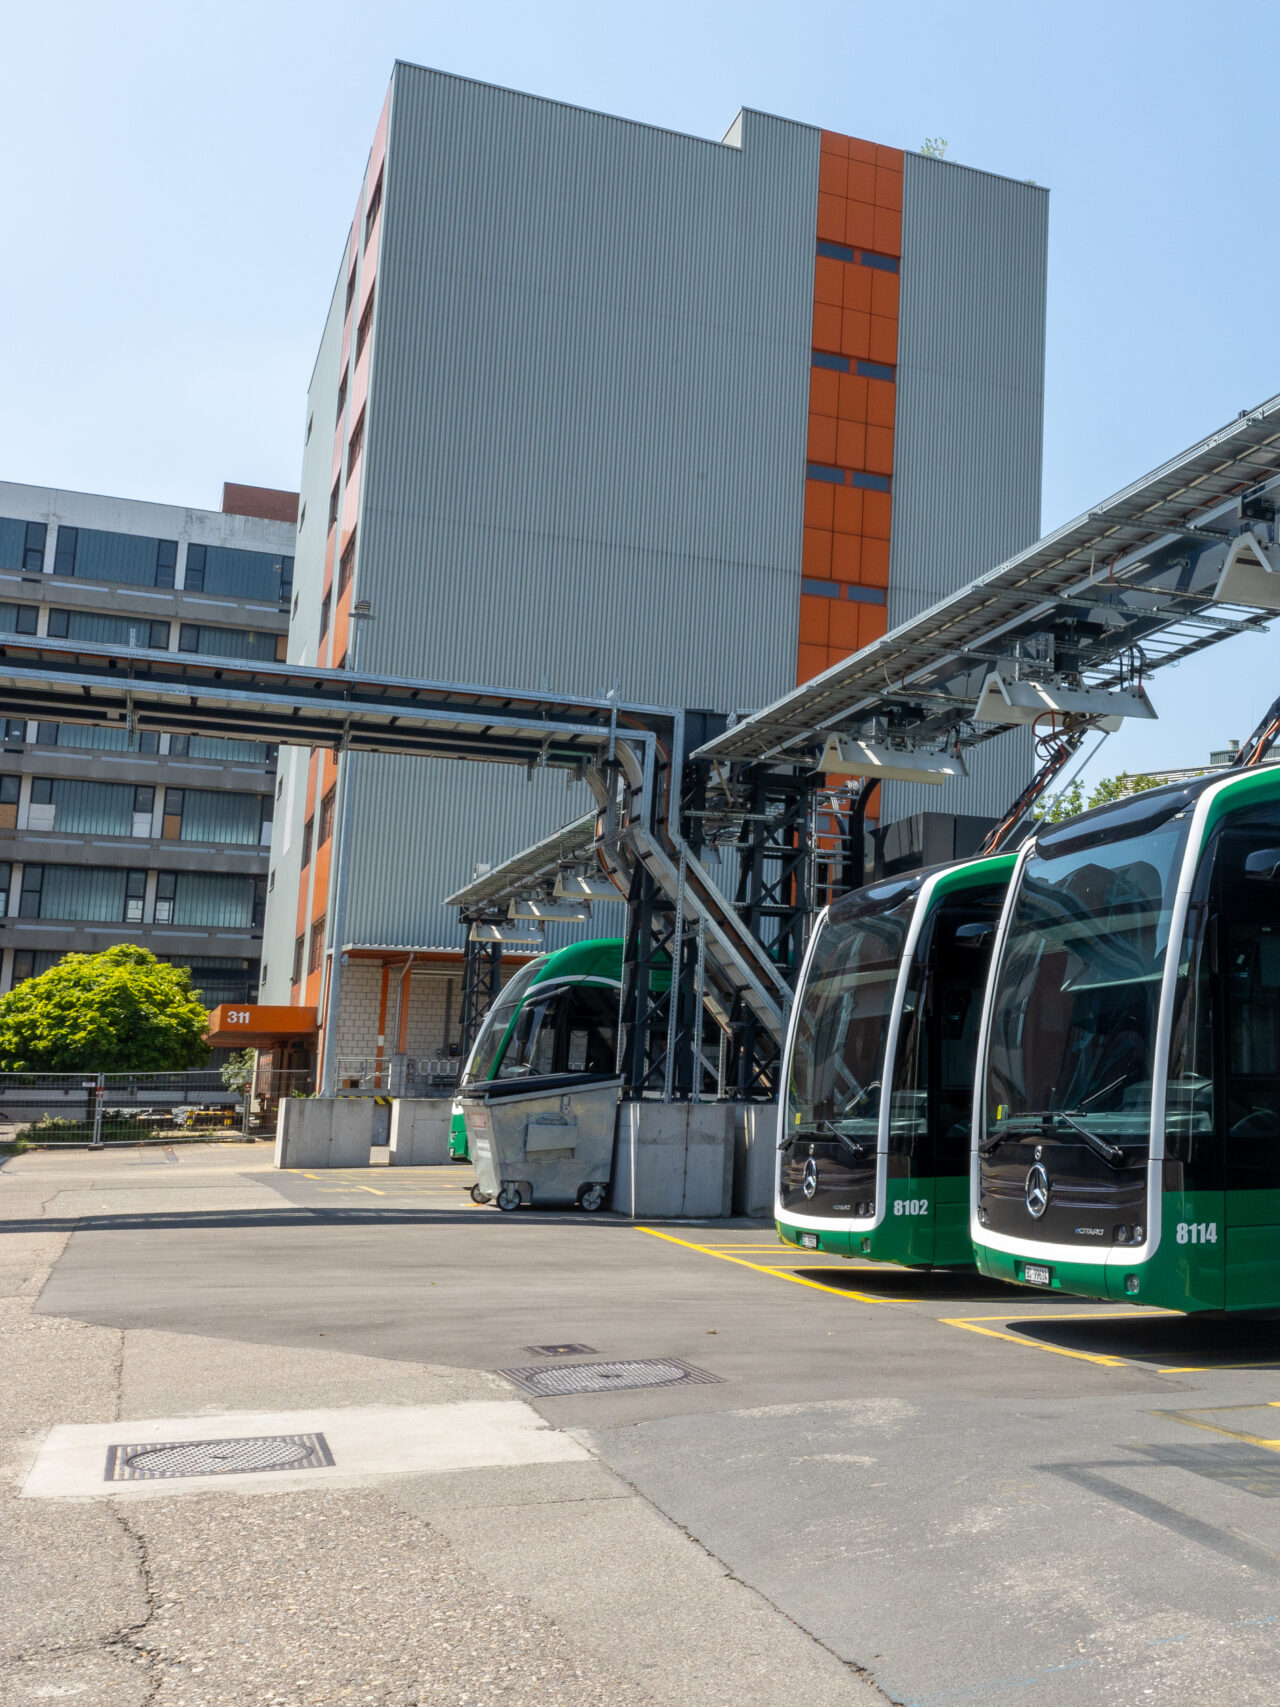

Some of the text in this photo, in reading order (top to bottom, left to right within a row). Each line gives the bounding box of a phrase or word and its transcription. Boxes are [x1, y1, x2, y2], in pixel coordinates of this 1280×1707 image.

[227, 1011, 250, 1024] 311
[893, 1199, 929, 1215] 8102
[1176, 1222, 1218, 1244] 8114
